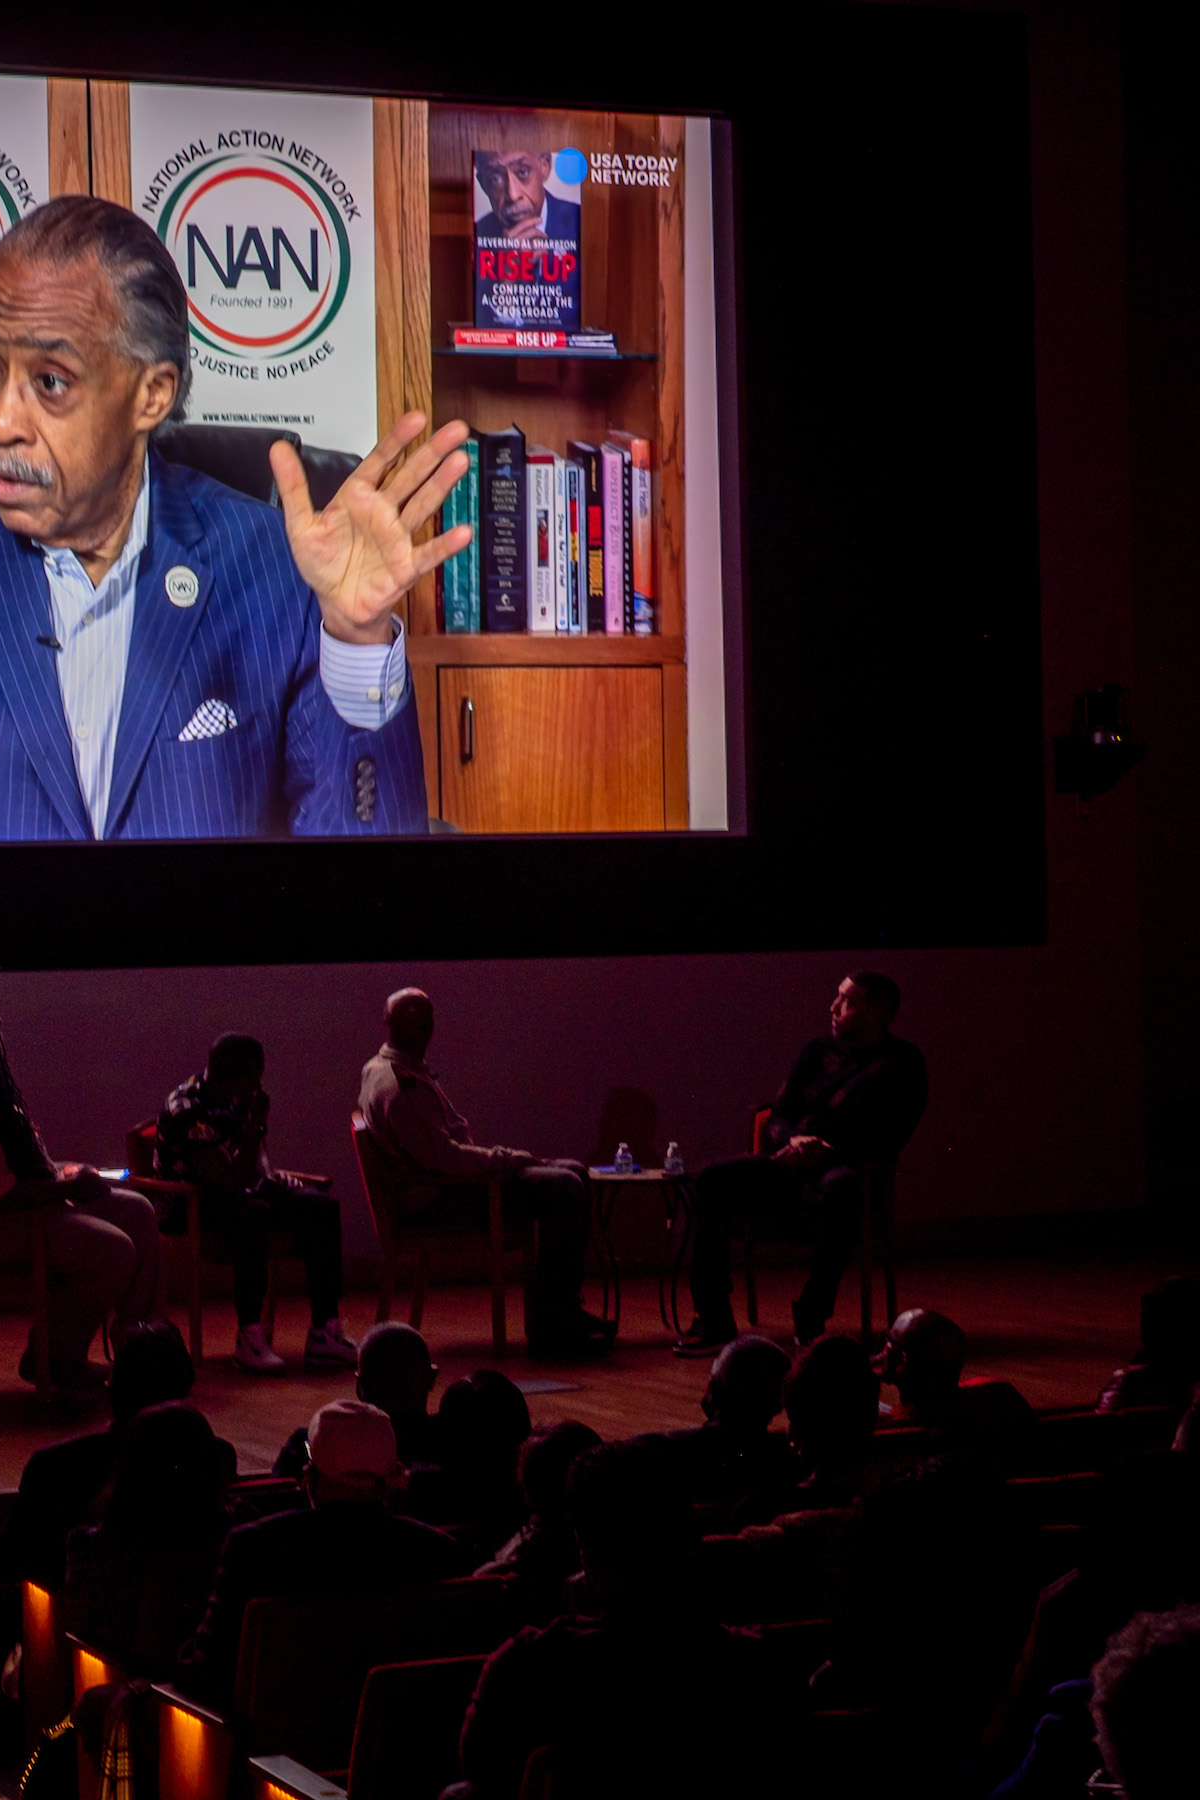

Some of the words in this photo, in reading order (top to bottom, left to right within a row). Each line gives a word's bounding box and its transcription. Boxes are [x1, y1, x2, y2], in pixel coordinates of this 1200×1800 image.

[590, 152, 622, 169] USA
[625, 154, 678, 172] TODAY
[142, 138, 213, 214] NATIONAL
[217, 129, 285, 153] ACTION
[288, 141, 362, 223] NETWORK
[590, 169, 671, 187] NETWORK
[477, 236, 520, 249] REVEREND
[521, 238, 531, 249] AL
[532, 238, 577, 251] SHARPTON
[186, 222, 318, 293] NAN
[479, 250, 534, 282] RISE
[541, 252, 576, 282] UP
[492, 283, 563, 297] CONFRONTING
[210, 294, 262, 309] Founded
[267, 297, 293, 309] 1991
[481, 294, 489, 305] A
[491, 294, 536, 307] COUNTRY
[539, 296, 551, 308] AT
[555, 296, 573, 309] THE
[496, 306, 560, 320] CROSSROADS
[515, 331, 540, 347] RISE
[541, 332, 558, 348] UP
[198, 353, 259, 380] JUSTICE
[267, 365, 287, 380] NO
[290, 339, 335, 376] PEACE
